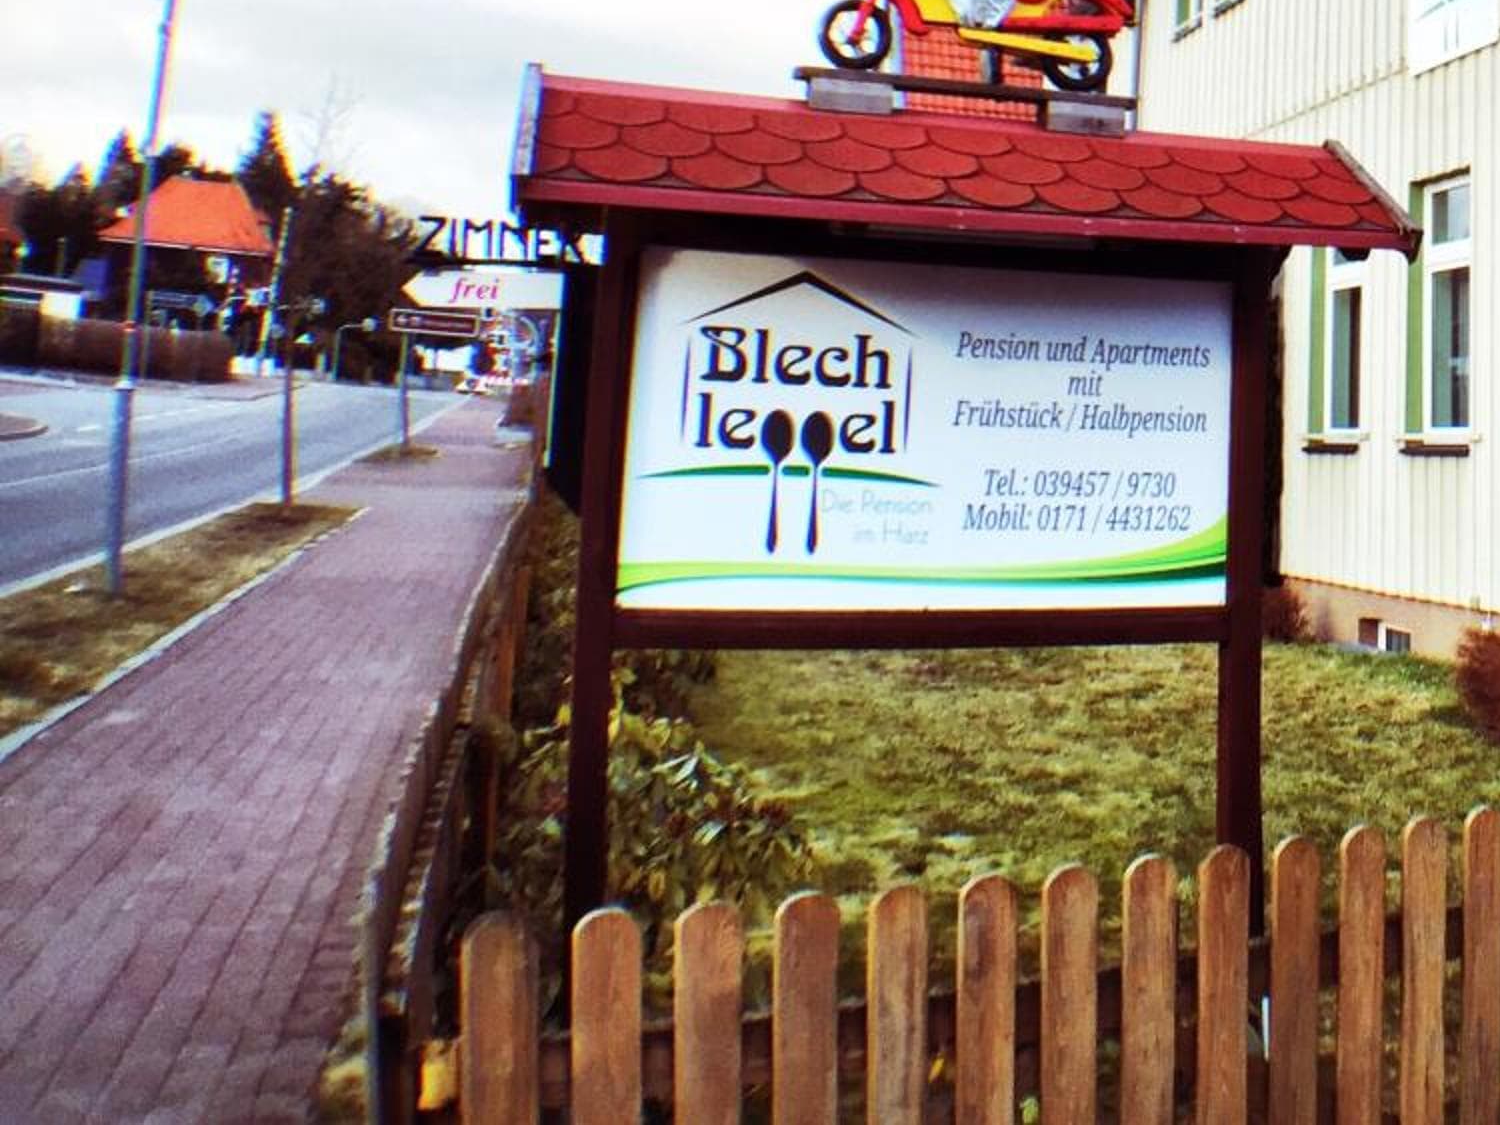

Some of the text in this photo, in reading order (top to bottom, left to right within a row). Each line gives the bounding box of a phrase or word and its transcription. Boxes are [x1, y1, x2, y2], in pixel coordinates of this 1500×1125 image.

[449, 276, 501, 304] frei
[699, 325, 892, 390] Blech
[956, 331, 1211, 371] Pension und Apartments
[1067, 370, 1103, 397] mit
[953, 399, 1064, 430] Frühstück
[1078, 402, 1207, 439] Halbpension
[984, 468, 1029, 497] Tel.:
[1033, 470, 1111, 498] 039457
[1127, 471, 1177, 499] 9730
[962, 503, 1033, 532] Mobil:
[1037, 504, 1087, 532] 0171
[1105, 505, 1192, 533] 4431262
